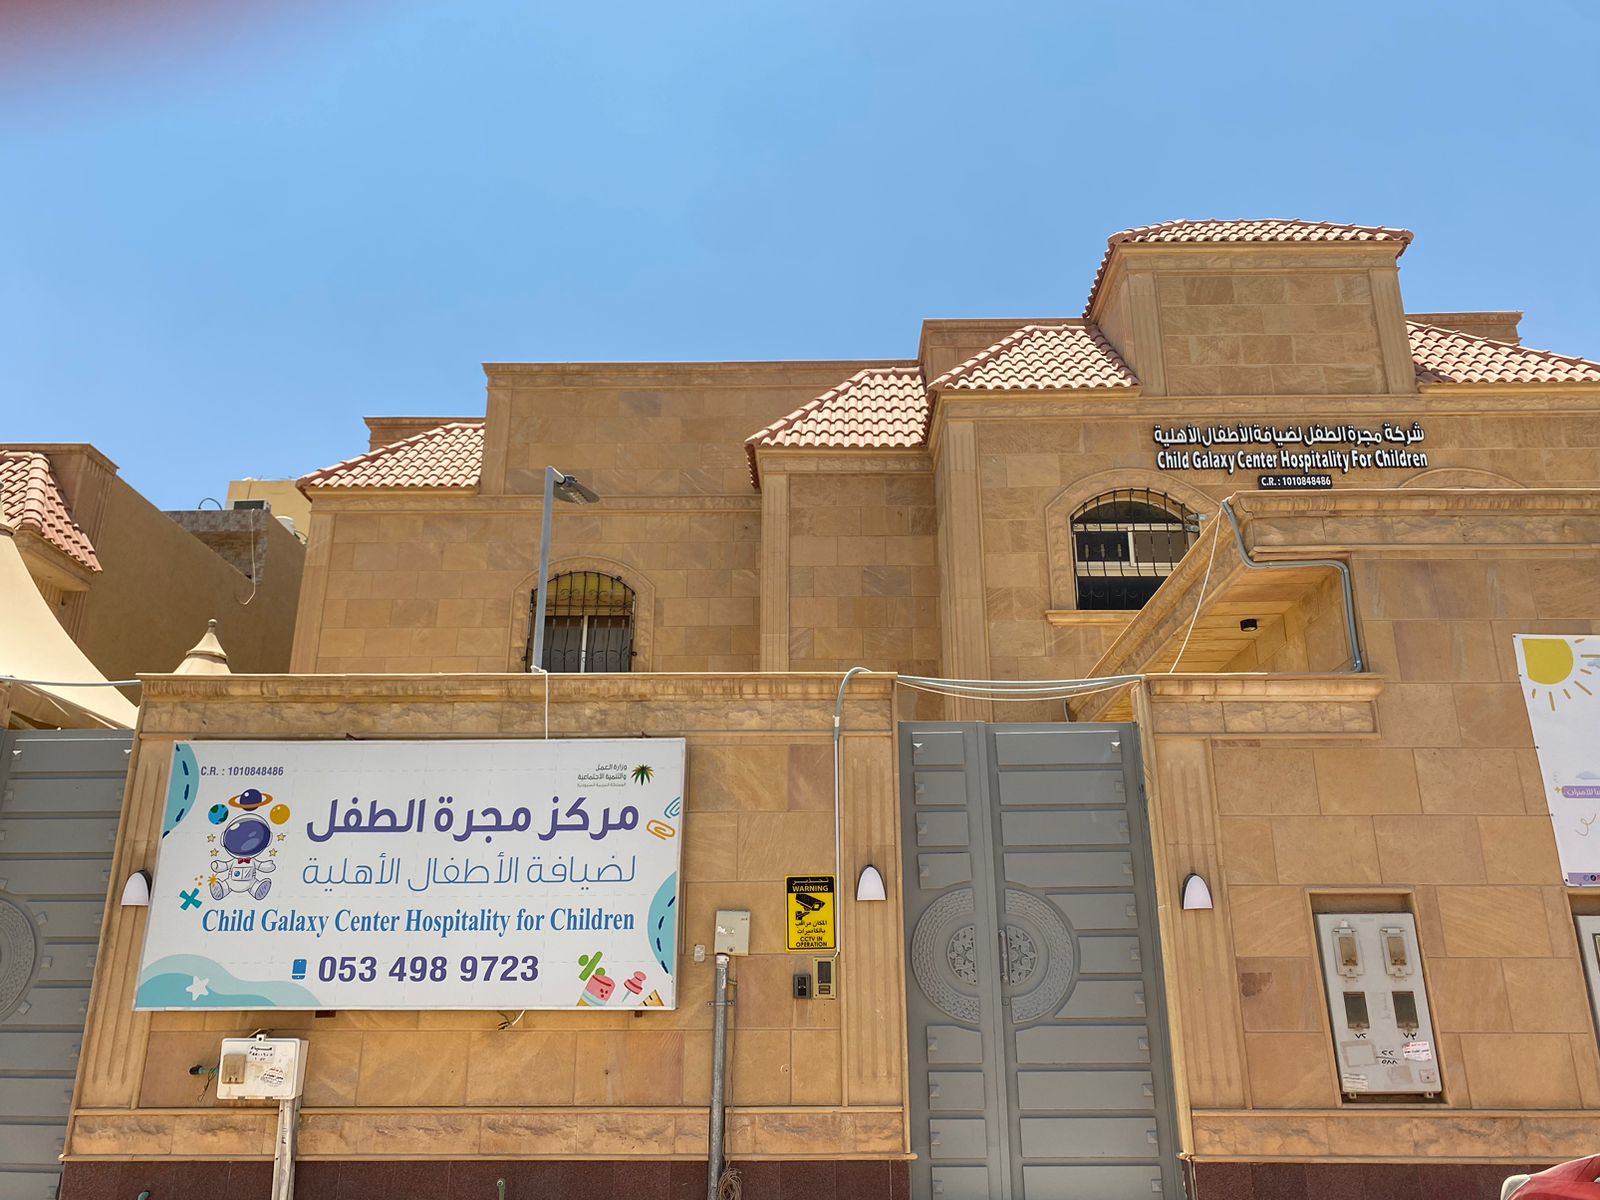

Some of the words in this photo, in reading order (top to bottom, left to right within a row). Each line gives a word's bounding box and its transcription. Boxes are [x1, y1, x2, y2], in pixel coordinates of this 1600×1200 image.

[1253, 424, 1303, 447] لضيافة
[1304, 424, 1347, 446] الطفل
[1347, 425, 1382, 446] مجرة
[1384, 422, 1425, 444] شركة
[1157, 451, 1190, 469] Child
[1192, 450, 1235, 474] Galaxy
[1237, 450, 1278, 469] Center
[1279, 449, 1350, 474] Hospitality
[1351, 449, 1373, 468] For
[1374, 448, 1429, 468] Children
[1282, 476, 1331, 486] 1010848486
[200, 766, 219, 776] C.R.
[228, 766, 284, 776] 1010848486
[306, 797, 427, 842] الطفل
[434, 796, 532, 843] مجرة
[538, 796, 639, 841] مركز
[302, 852, 401, 892] الأهلية
[407, 851, 519, 892] الأطفال
[527, 855, 636, 891] لضيافة
[202, 908, 256, 932] Child
[261, 908, 329, 938] Galaxy
[334, 908, 400, 932] Center
[404, 908, 511, 938] Hospitality
[516, 908, 545, 931] for
[550, 907, 635, 931] Children
[318, 955, 378, 983] 053
[388, 955, 448, 983] 498
[459, 955, 539, 982] 9723
